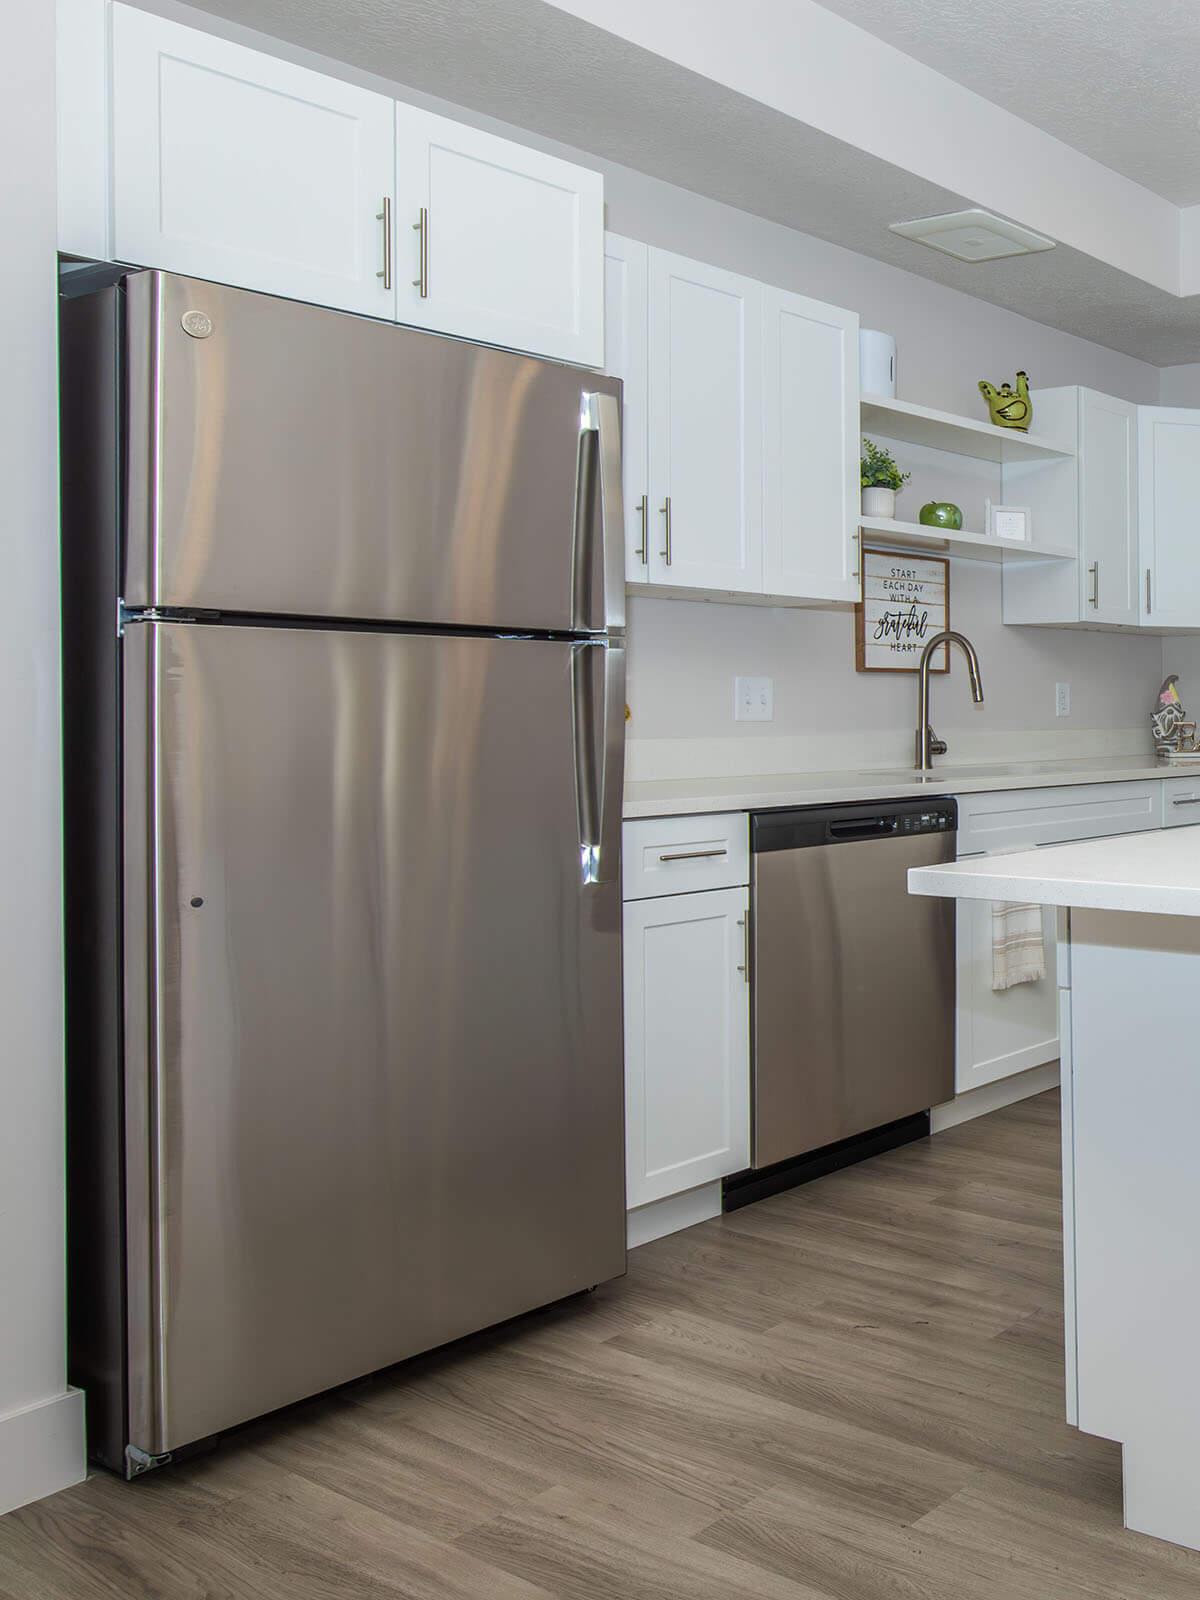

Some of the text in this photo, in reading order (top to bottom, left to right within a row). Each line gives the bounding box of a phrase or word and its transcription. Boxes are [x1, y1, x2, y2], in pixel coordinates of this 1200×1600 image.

[890, 568, 916, 579] START
[883, 580, 924, 592] EACH DAY
[889, 593, 919, 604] WITH A
[873, 605, 928, 641] grateful
[890, 642, 917, 653] HEART
